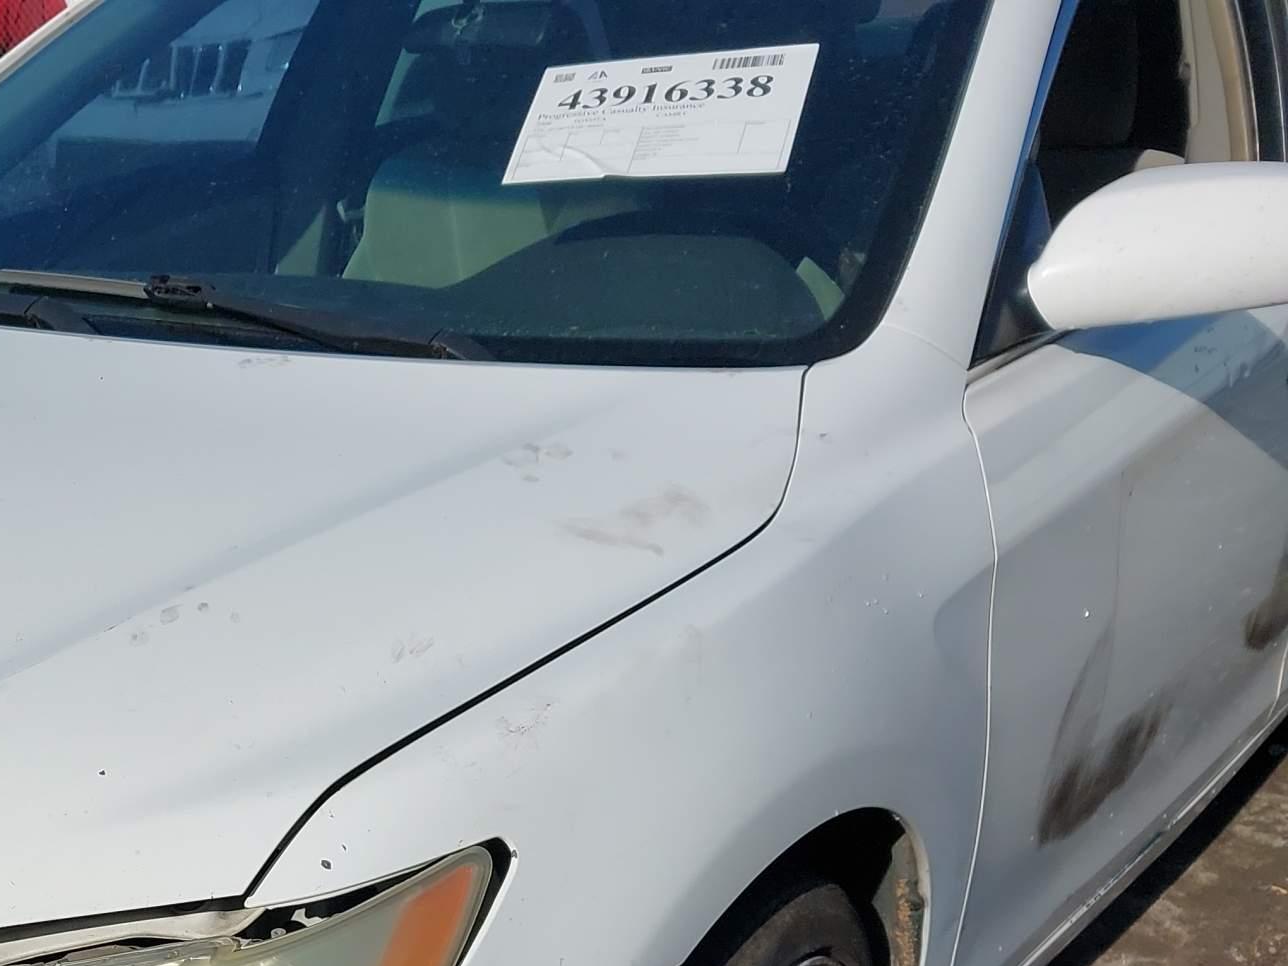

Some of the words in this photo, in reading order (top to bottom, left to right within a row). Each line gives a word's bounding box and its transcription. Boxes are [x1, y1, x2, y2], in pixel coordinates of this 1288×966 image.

[558, 75, 774, 110] 43916338
[537, 109, 600, 120] Progressive
[601, 105, 647, 115] Casualty
[652, 103, 706, 112] Insurance
